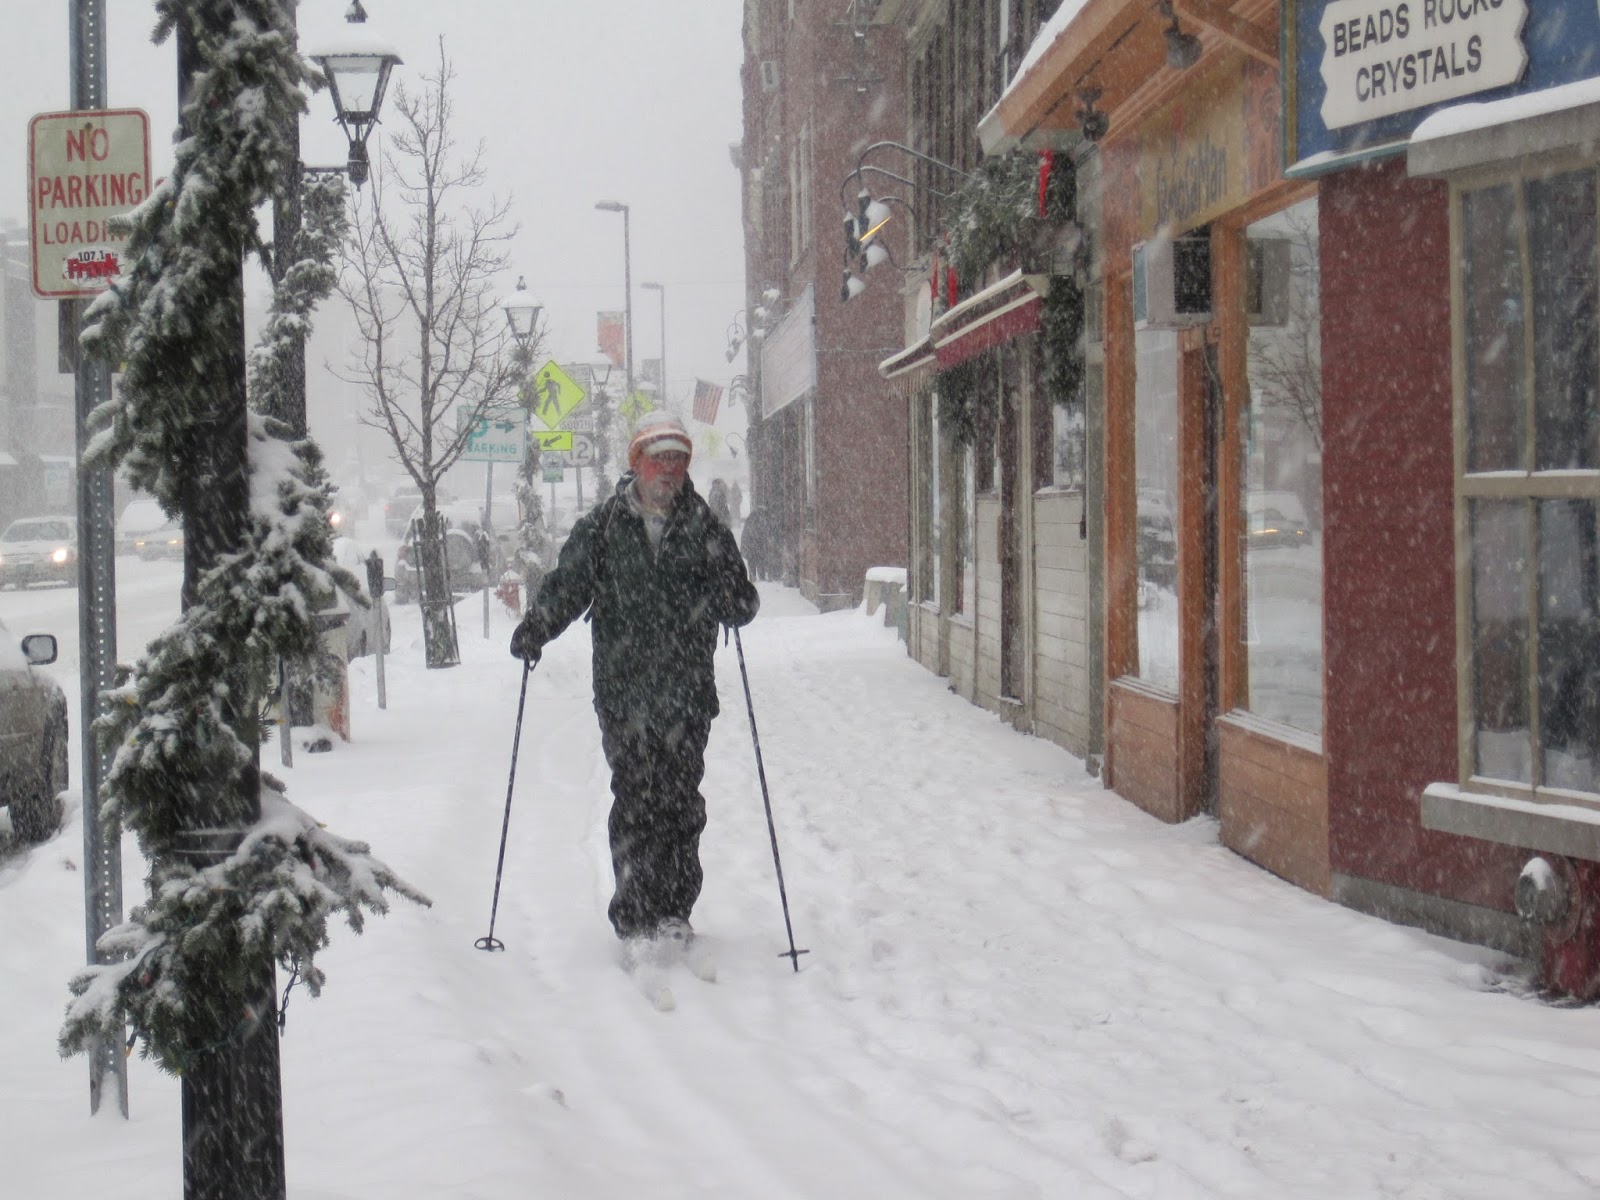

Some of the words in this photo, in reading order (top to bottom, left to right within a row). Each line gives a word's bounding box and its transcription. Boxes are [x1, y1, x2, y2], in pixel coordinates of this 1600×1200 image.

[1334, 4, 1409, 57] BEADS
[1424, 0, 1503, 30] ROC
[1355, 35, 1482, 102] CRYSTALS
[66, 128, 109, 162] NO
[38, 172, 142, 209] PARKING
[43, 220, 126, 244] LOADI
[78, 250, 105, 262] 107.1
[561, 419, 593, 430] SOUTH
